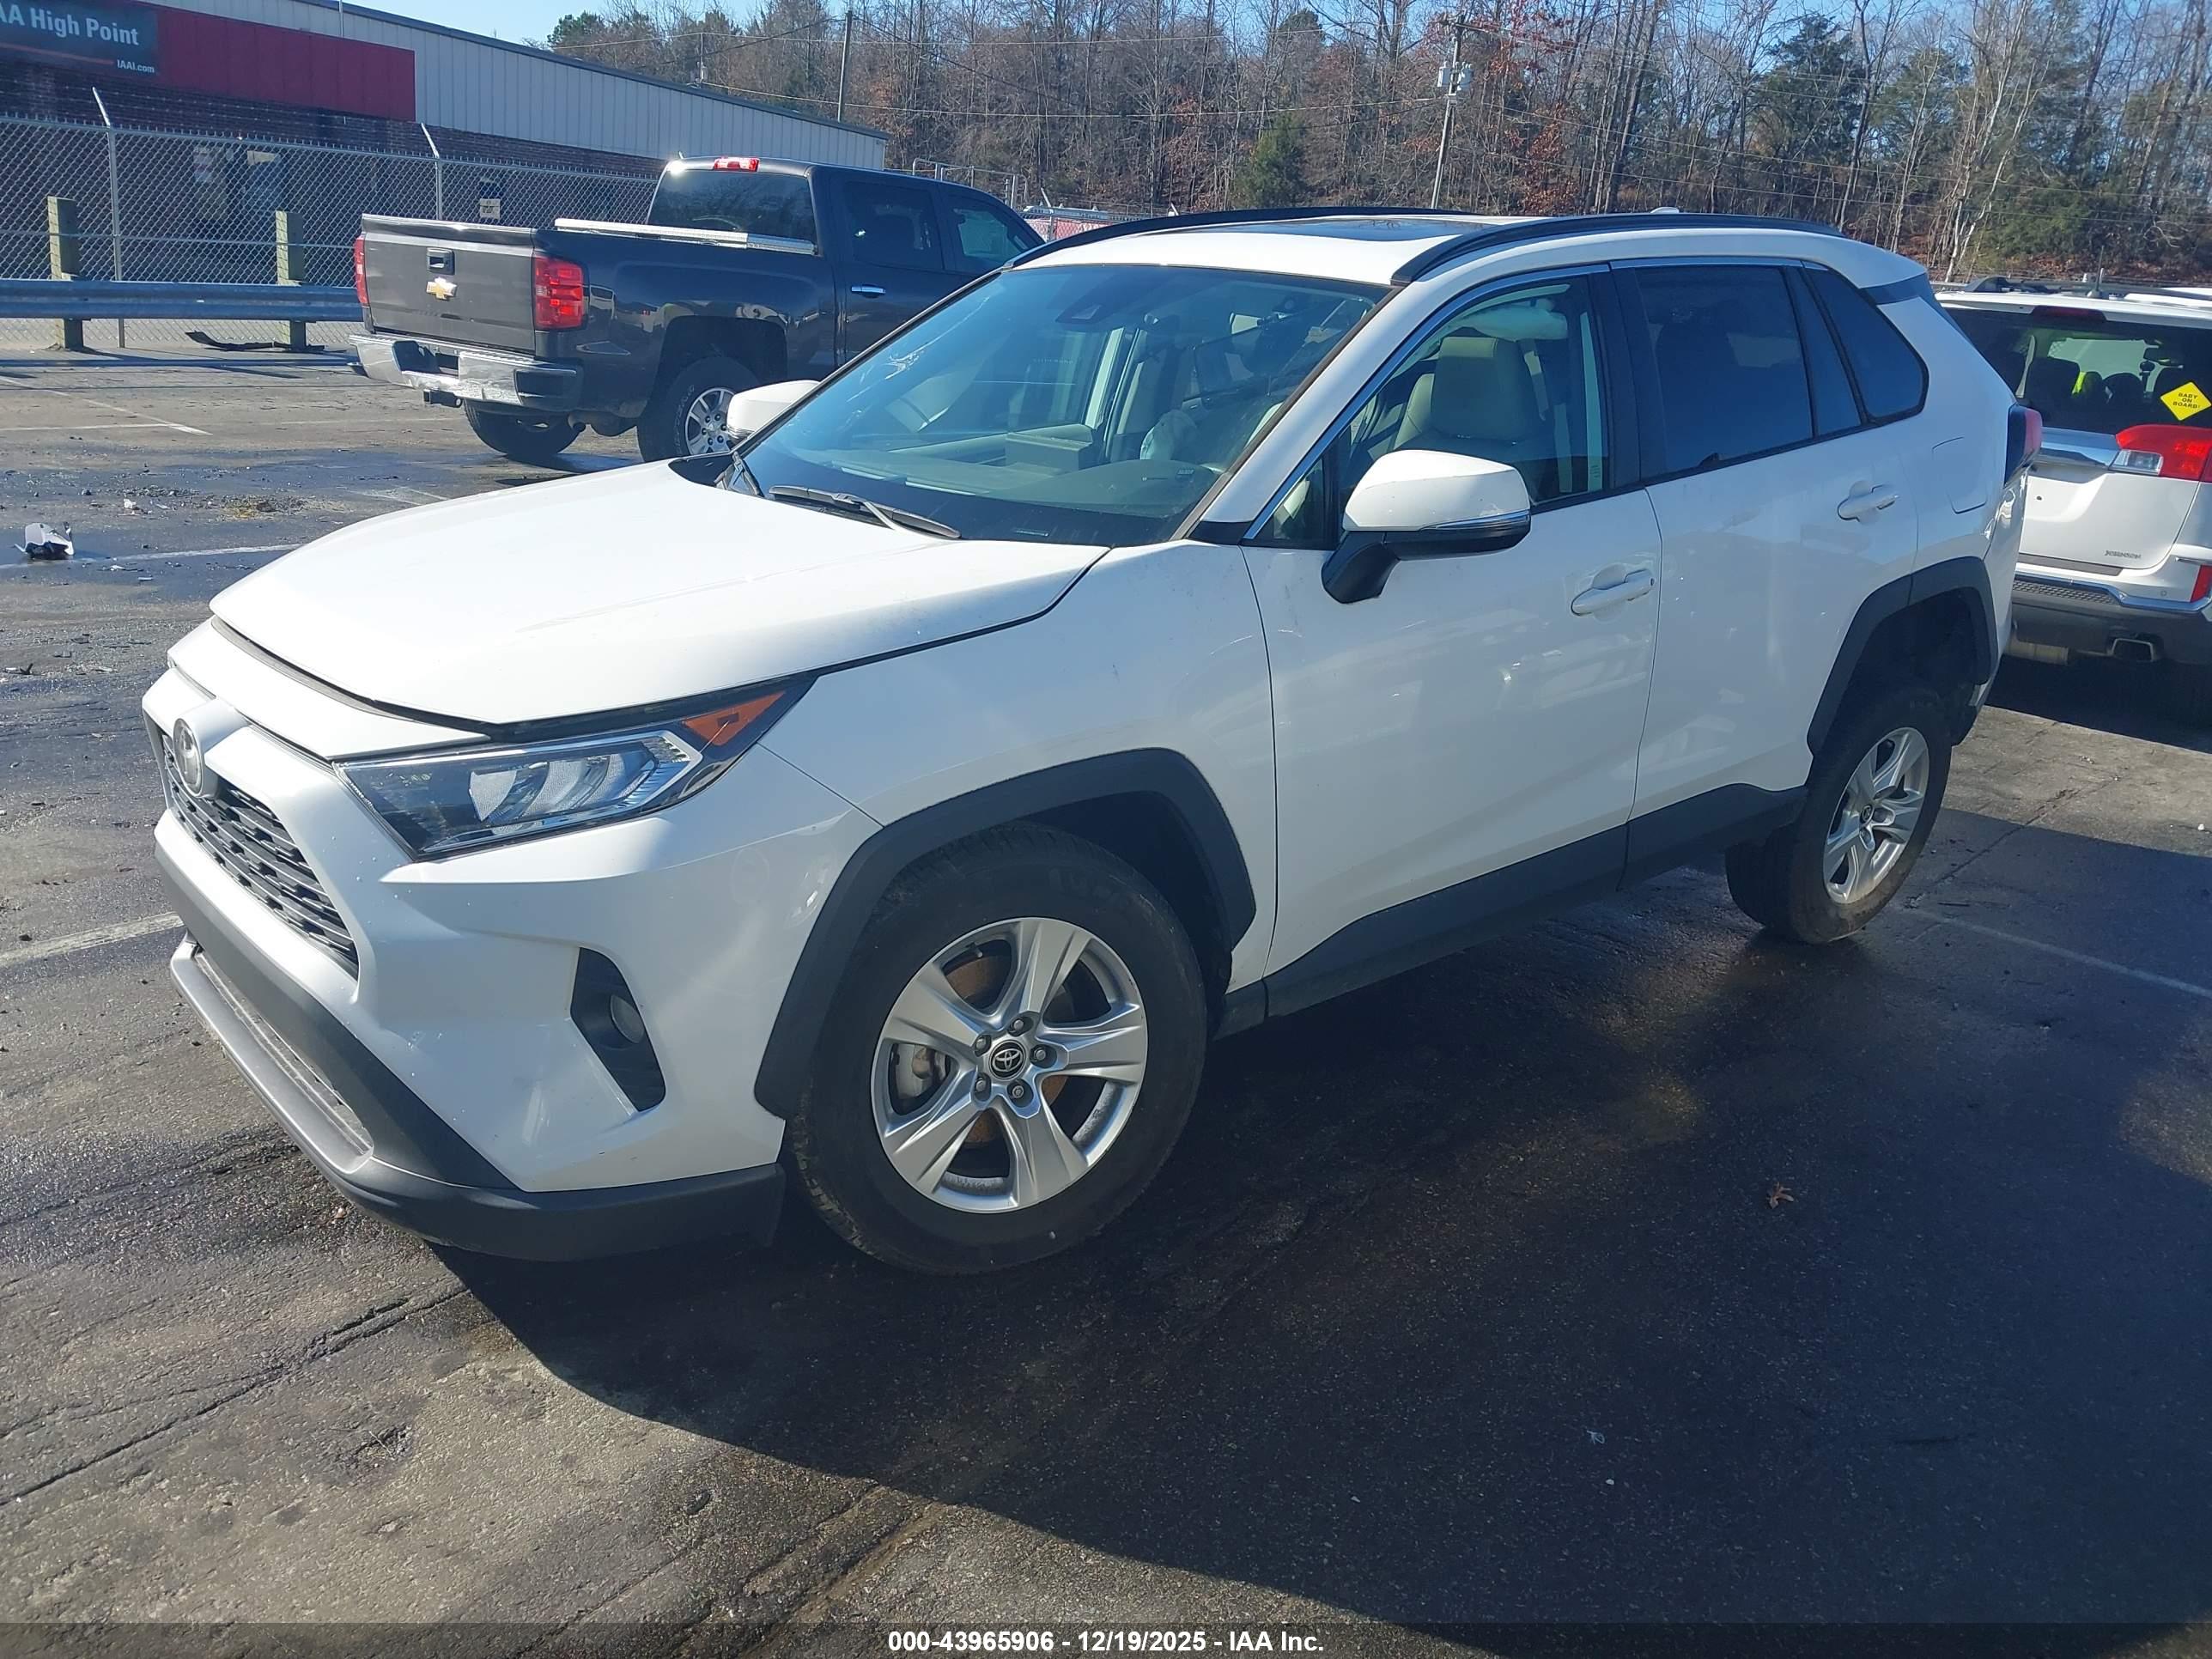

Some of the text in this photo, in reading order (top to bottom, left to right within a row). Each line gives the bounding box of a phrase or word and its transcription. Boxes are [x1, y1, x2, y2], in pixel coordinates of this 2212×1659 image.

[30, 8, 81, 38] High
[86, 17, 139, 46] Point
[117, 59, 155, 73] IAAI.com
[2178, 392, 2198, 401] BABY
